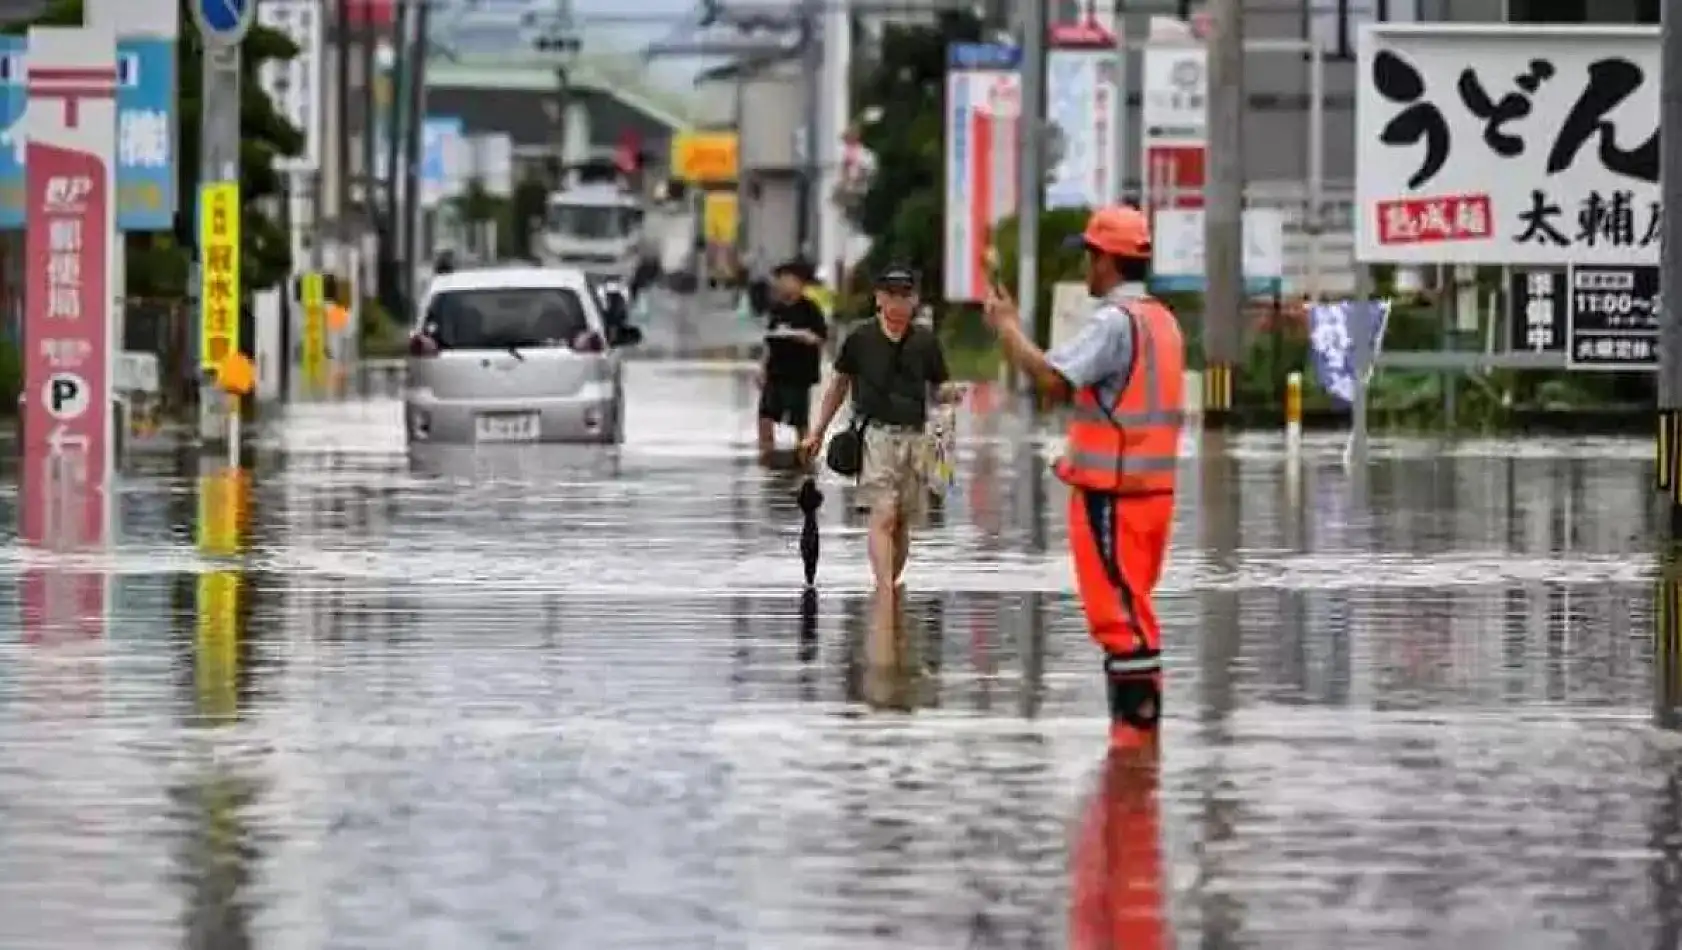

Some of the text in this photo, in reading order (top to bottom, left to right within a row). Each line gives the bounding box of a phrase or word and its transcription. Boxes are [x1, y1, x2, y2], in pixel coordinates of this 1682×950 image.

[1373, 49, 1660, 189] うどん
[49, 219, 84, 319] 郵便局
[1526, 272, 1554, 353] 準備中
[52, 379, 78, 412] P
